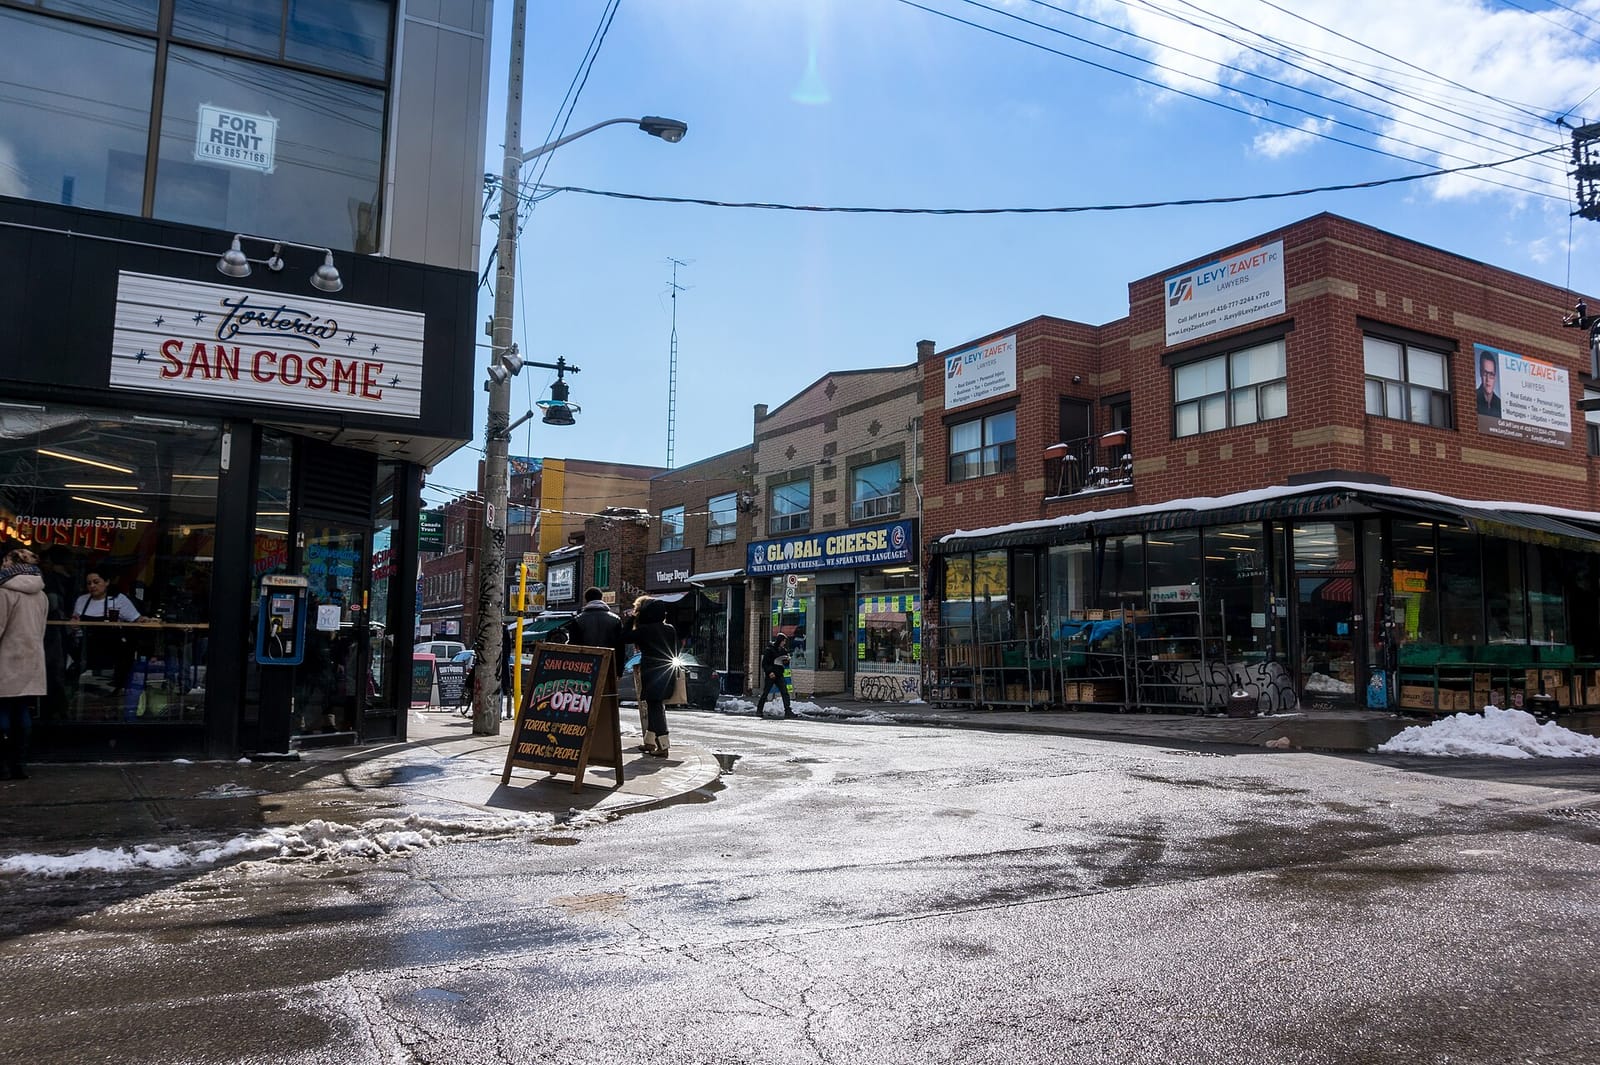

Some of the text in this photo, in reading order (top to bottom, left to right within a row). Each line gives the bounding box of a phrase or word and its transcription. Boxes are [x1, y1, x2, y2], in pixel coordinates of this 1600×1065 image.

[218, 114, 257, 134] FOR
[210, 128, 263, 151] RENT
[204, 144, 222, 155] 416
[1197, 252, 1278, 286] LEVY ZAVET PC
[1217, 275, 1250, 292] LAWYERS
[1178, 315, 1188, 324] Call
[1188, 312, 1198, 322] Jeff
[1198, 309, 1209, 320] Levy
[964, 352, 983, 364] LEVY
[984, 343, 1008, 358] ZAVET
[160, 339, 384, 400] SAN COSME
[1505, 357, 1529, 373] LEVY
[1530, 364, 1557, 381] ZAVET
[1522, 380, 1545, 392] LAWYERS
[767, 529, 888, 562] GLOBAL CHEESE
[836, 557, 854, 565] SPEAK
[854, 554, 871, 563] YOUR
[656, 570, 689, 583] Vintage Depot
[544, 659, 593, 674] SAN COSME
[530, 679, 592, 708] ABIERTO
[550, 691, 593, 713] OPEN
[524, 719, 550, 732] TORTAS
[559, 723, 587, 737] PUEBLO
[518, 742, 545, 756] TORTAS
[553, 747, 580, 760] PEOPLE
